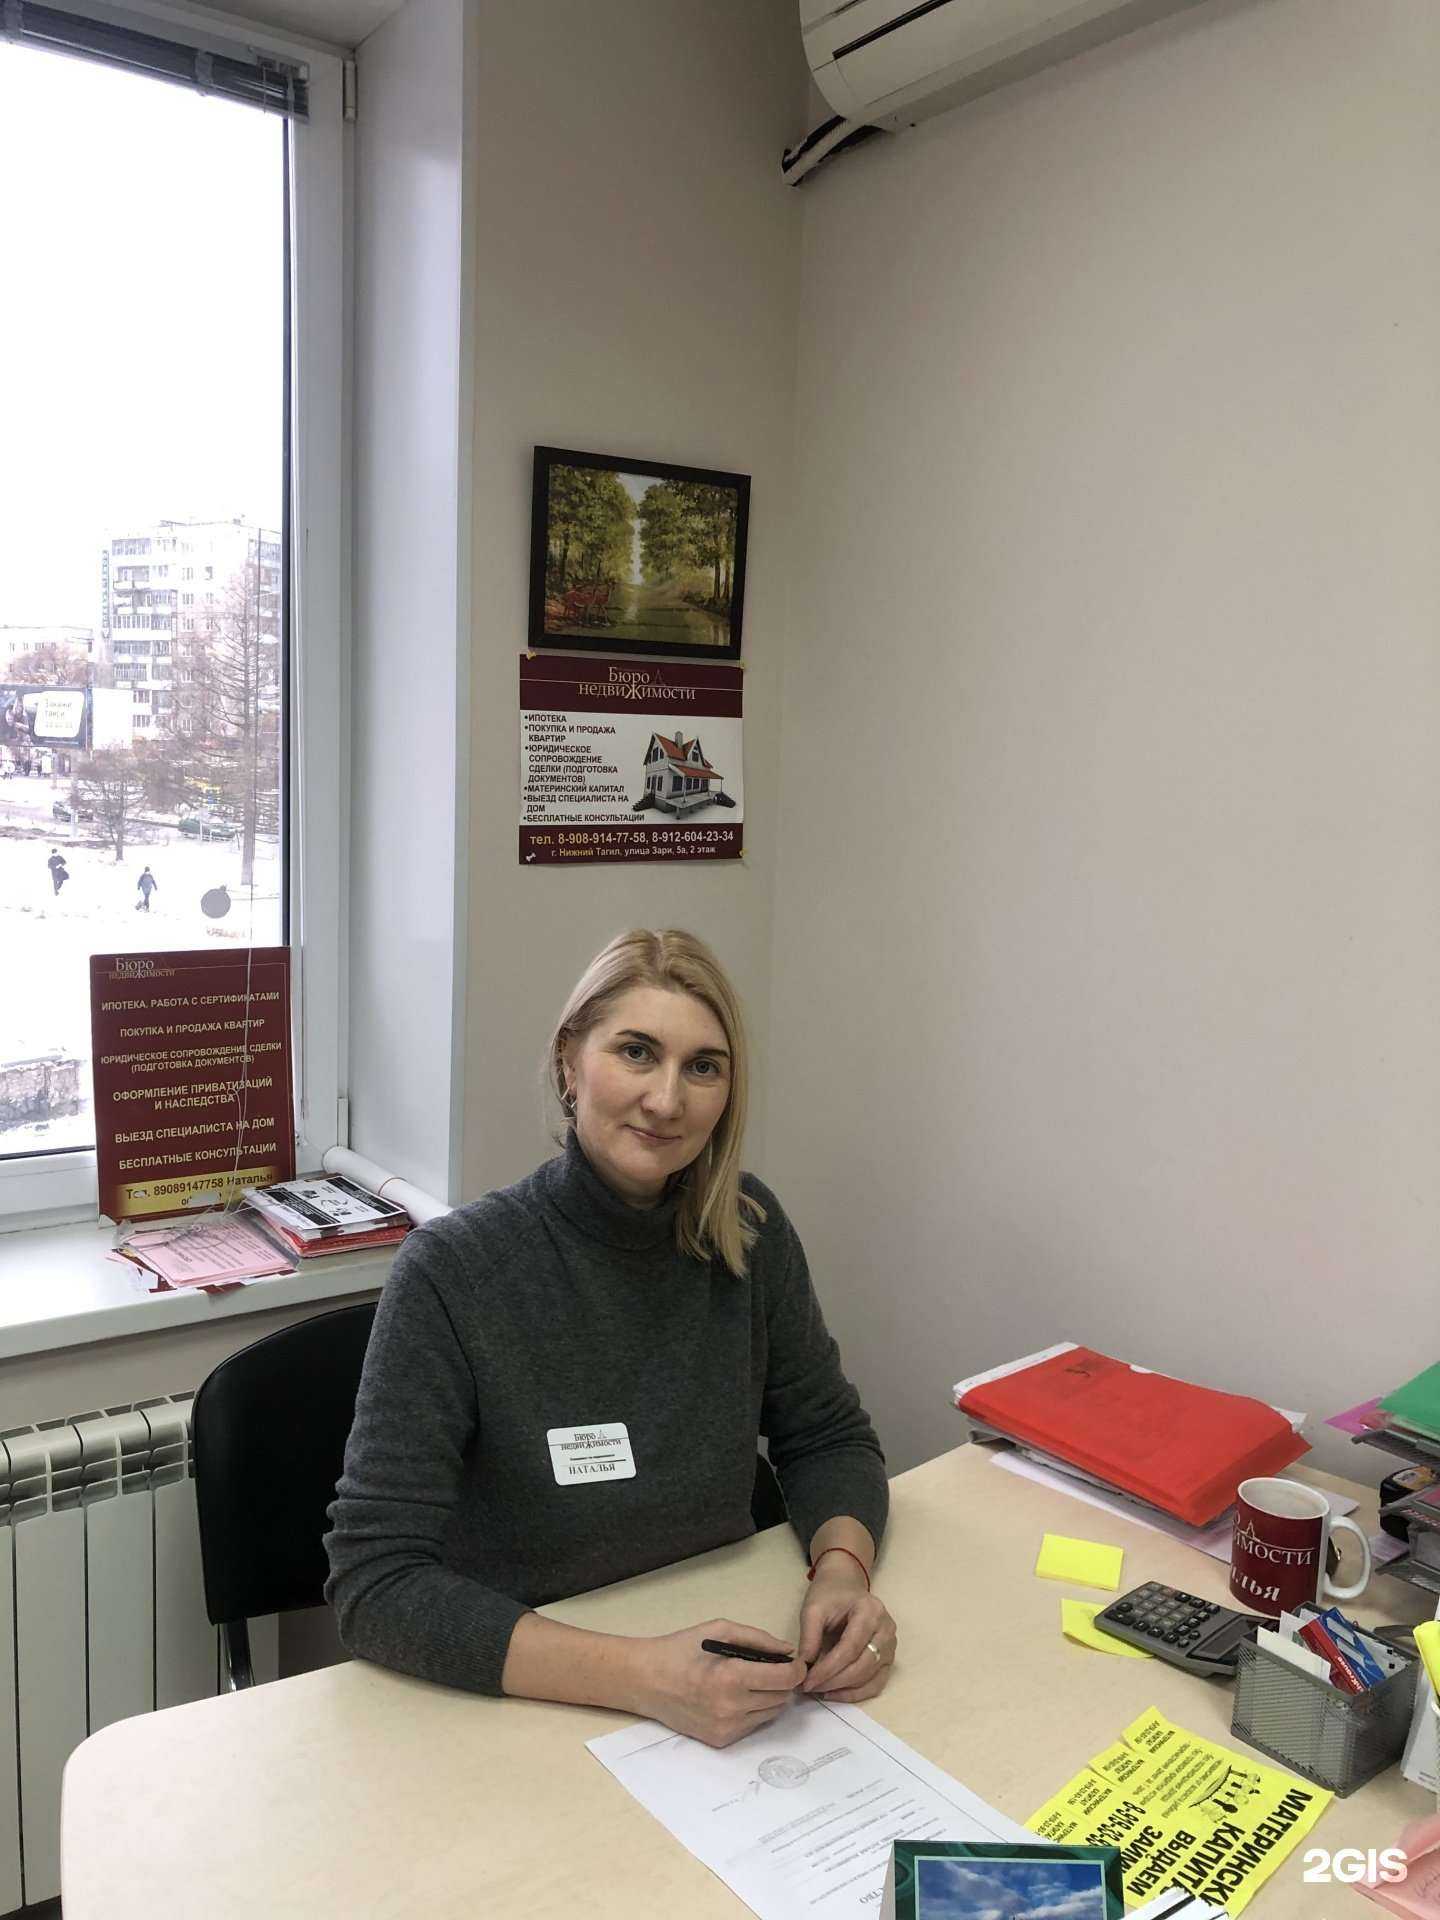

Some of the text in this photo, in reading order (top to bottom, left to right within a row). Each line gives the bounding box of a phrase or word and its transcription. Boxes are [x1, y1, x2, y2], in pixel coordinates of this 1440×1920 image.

[608, 666, 650, 685] Бюро
[528, 714, 567, 723] ИПОТЕКА
[528, 724, 566, 733] ПОКУПКА
[576, 725, 616, 735] ПРОДАЖА
[528, 734, 566, 743] КВАРТИР
[529, 744, 592, 754] ЮРИДИЧЕСКОЕ
[529, 754, 602, 764] СОПРОВОЖДЕНИЕ
[529, 764, 618, 774] СДЕЛКИ (ПОДГОТОВКА
[528, 774, 585, 784] ДОКУМЕНТОВ)
[527, 783, 625, 793] МАТЕРИНСКИЙ КАПИТАЛ
[527, 794, 556, 803] ВЫЕЗД
[558, 794, 616, 803] СПЕЦИАЛИСТА
[526, 804, 545, 813] ДОМ
[527, 814, 645, 823] БЕСПЛАТНЫЕ КОНСУЛЬТАЦИИ
[529, 831, 734, 845] тел. 8-908-914-77-58, 8-912-604-23-34
[559, 847, 593, 857] Нижний
[624, 848, 650, 857] улица
[690, 845, 695, 854] 2
[696, 846, 716, 854] этаж
[115, 957, 154, 973] Бюро
[151, 997, 190, 1008] РАБОТА
[191, 996, 198, 1006] С
[200, 992, 280, 1006] СЕРТИФИКАТАМИ
[120, 1018, 265, 1037] ПОКУПКА И ПРОДАЖА КВАРТИР
[100, 1042, 282, 1065] ЮРИДИЧЕСКОЕ СОПРОВОЖДЕНИЕ СДЕЛКИ
[131, 1055, 255, 1074] (ПОДГОТОВКА ДОКУМЕНТОВ)
[112, 1085, 188, 1102] ОФОРМЛЕНИЕ
[154, 1094, 235, 1110] И НАСЛЕДСТВА
[115, 1116, 275, 1144] ВЫЕЗД СПЕЦИАЛИСТА НА ДОМ
[119, 1142, 277, 1170] БЕСПЛАТНЫЕ КОНСУЛЬТАЦИИ
[153, 1178, 224, 1196] 89089147758
[1122, 1824, 1165, 1874] ЗАЙМ
[1125, 1829, 1197, 1897] ВЫДАЕМ
[1159, 1821, 1246, 1895] КАПИТА
